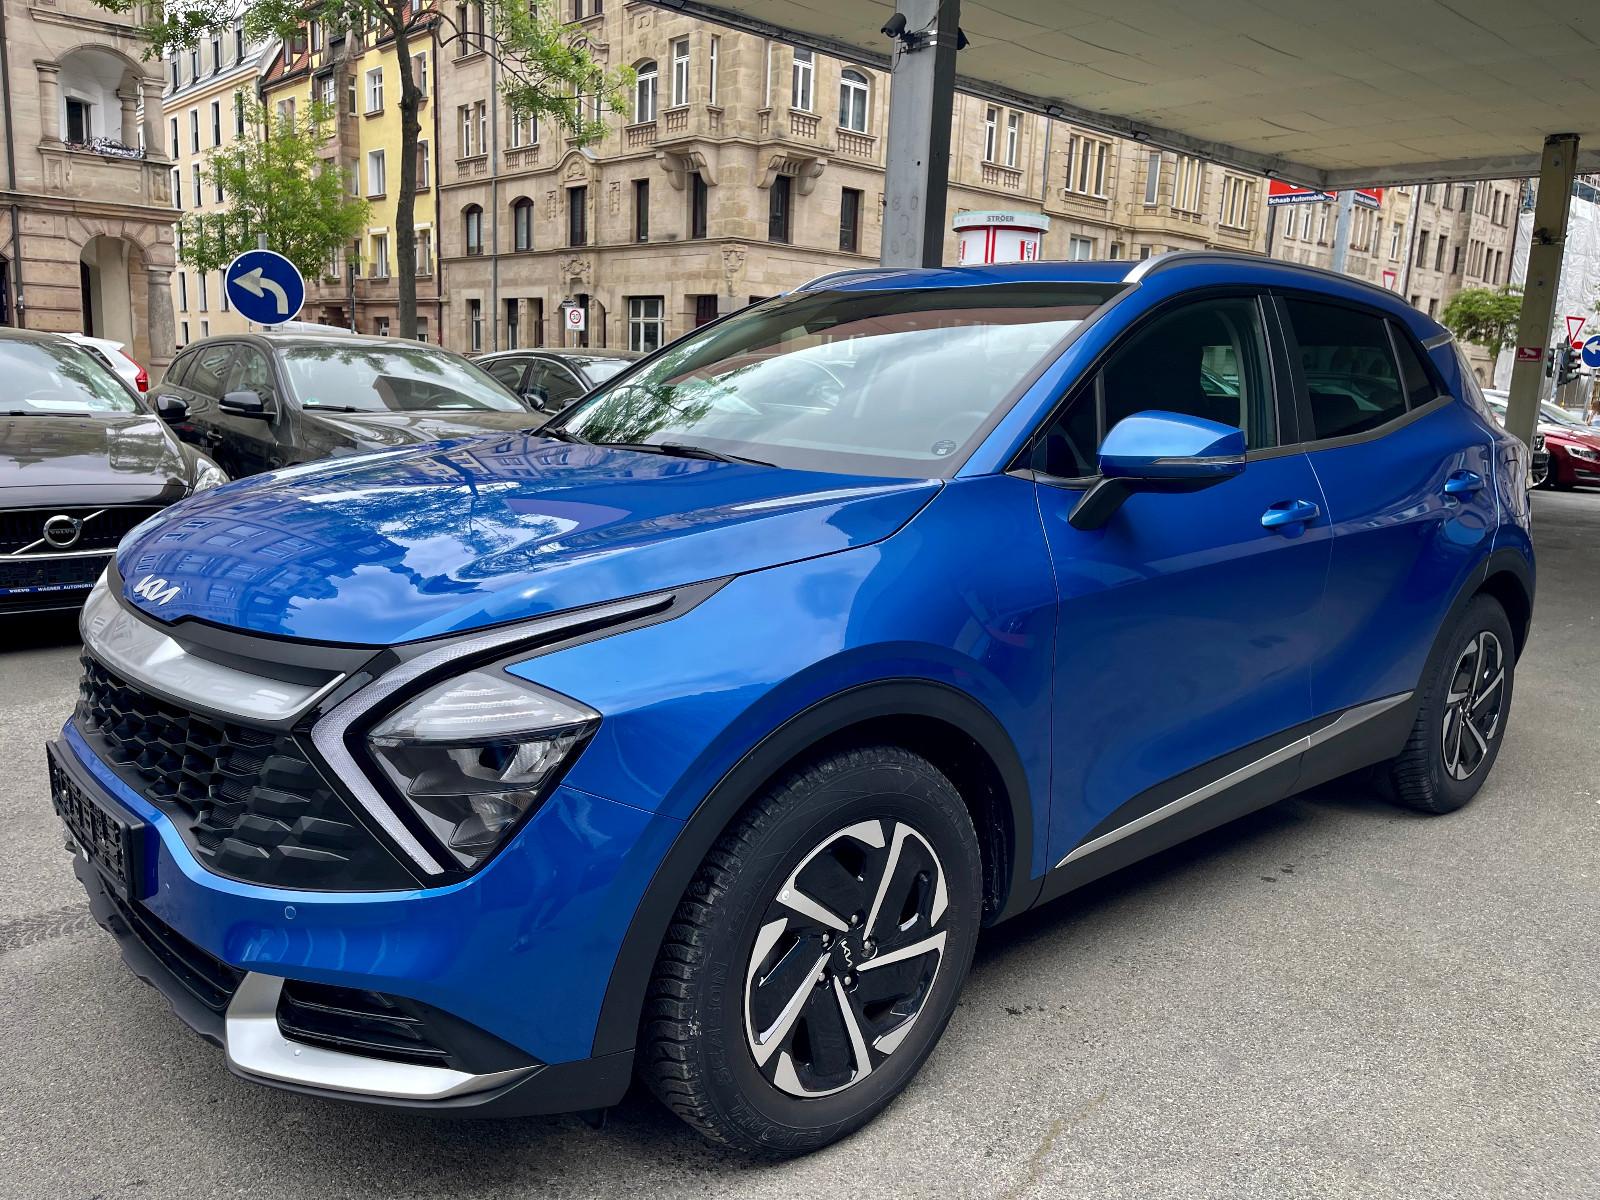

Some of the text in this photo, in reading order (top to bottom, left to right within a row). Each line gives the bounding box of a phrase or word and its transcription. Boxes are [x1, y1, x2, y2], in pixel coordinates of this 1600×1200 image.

[1269, 197, 1290, 205] Schaab
[986, 215, 1015, 223] STRÖER
[572, 313, 581, 321] 30
